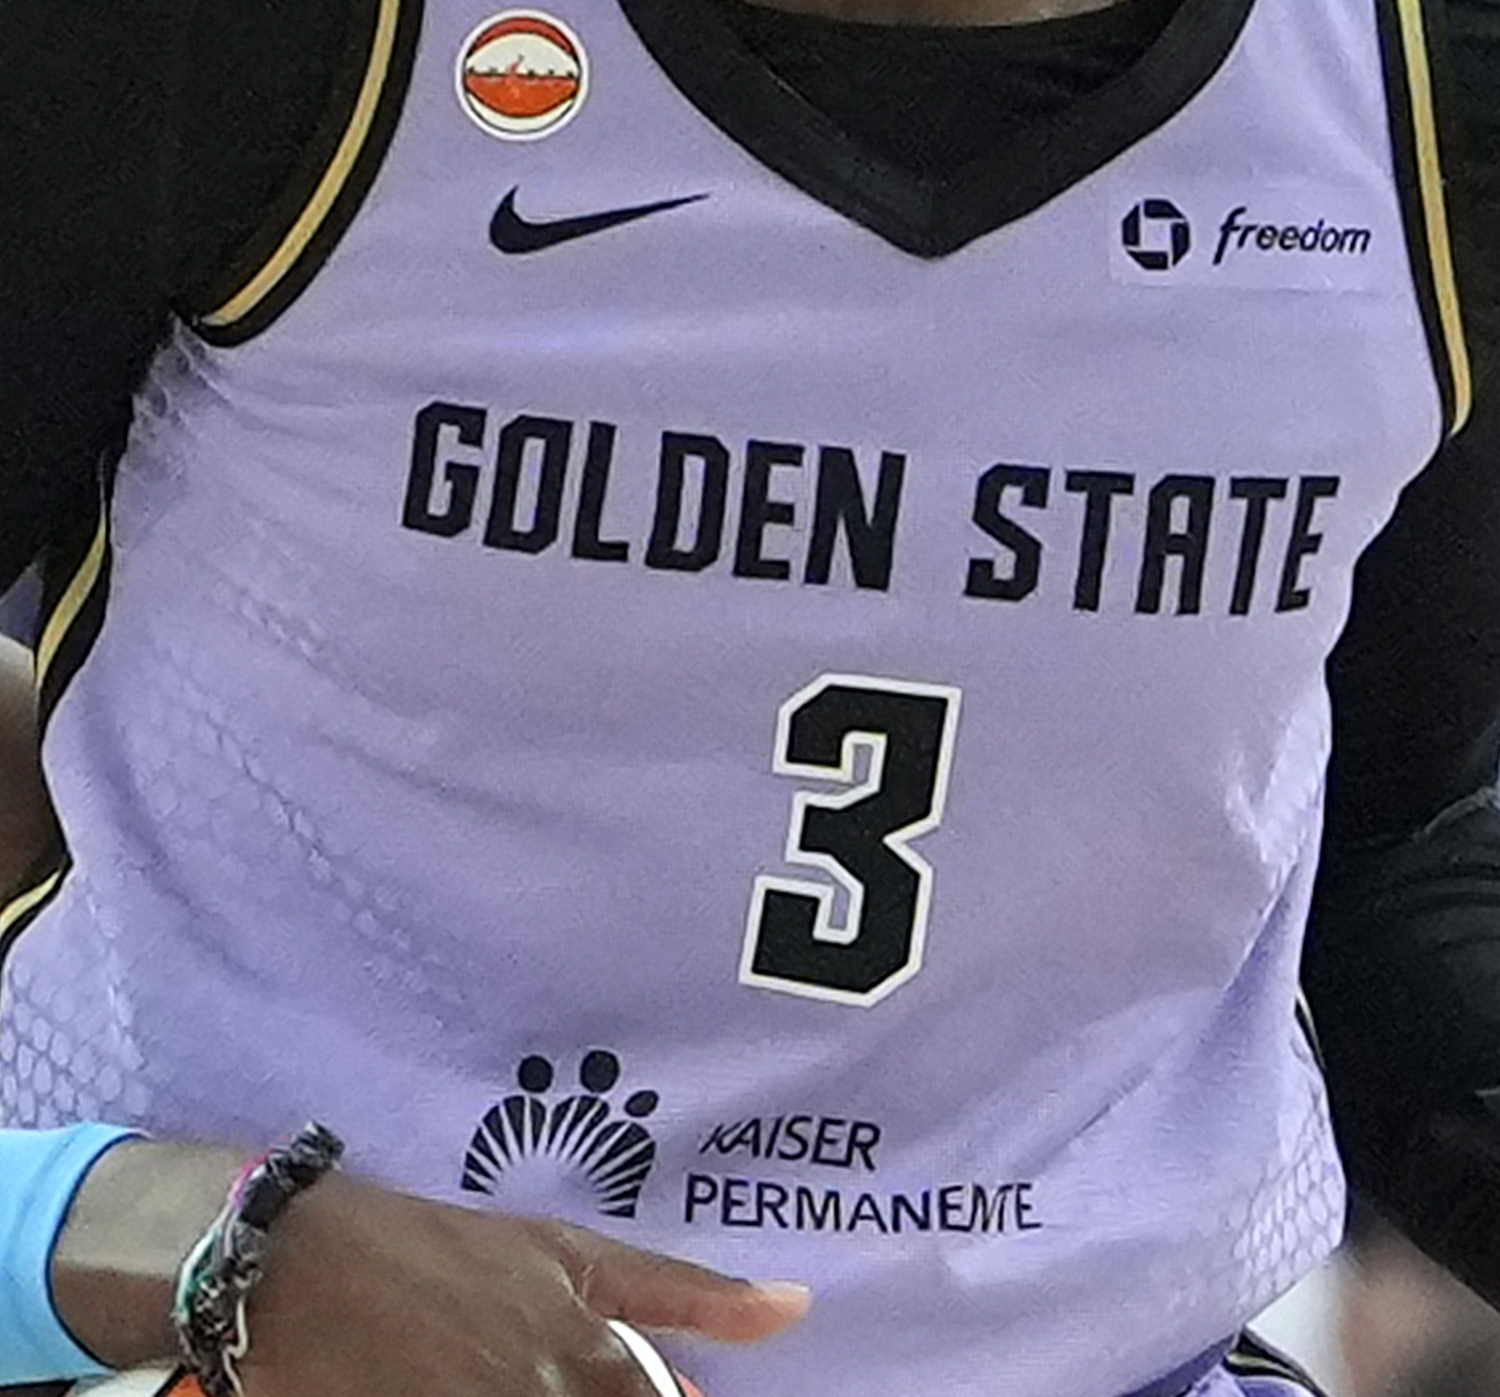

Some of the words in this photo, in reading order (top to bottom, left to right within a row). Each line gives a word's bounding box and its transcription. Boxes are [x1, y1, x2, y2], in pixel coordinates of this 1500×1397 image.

[1212, 205, 1372, 266] freedom
[401, 399, 907, 593] GOLDEN
[963, 461, 1342, 617] STATE
[738, 671, 963, 1007] 3
[699, 1114, 882, 1171] KAISER
